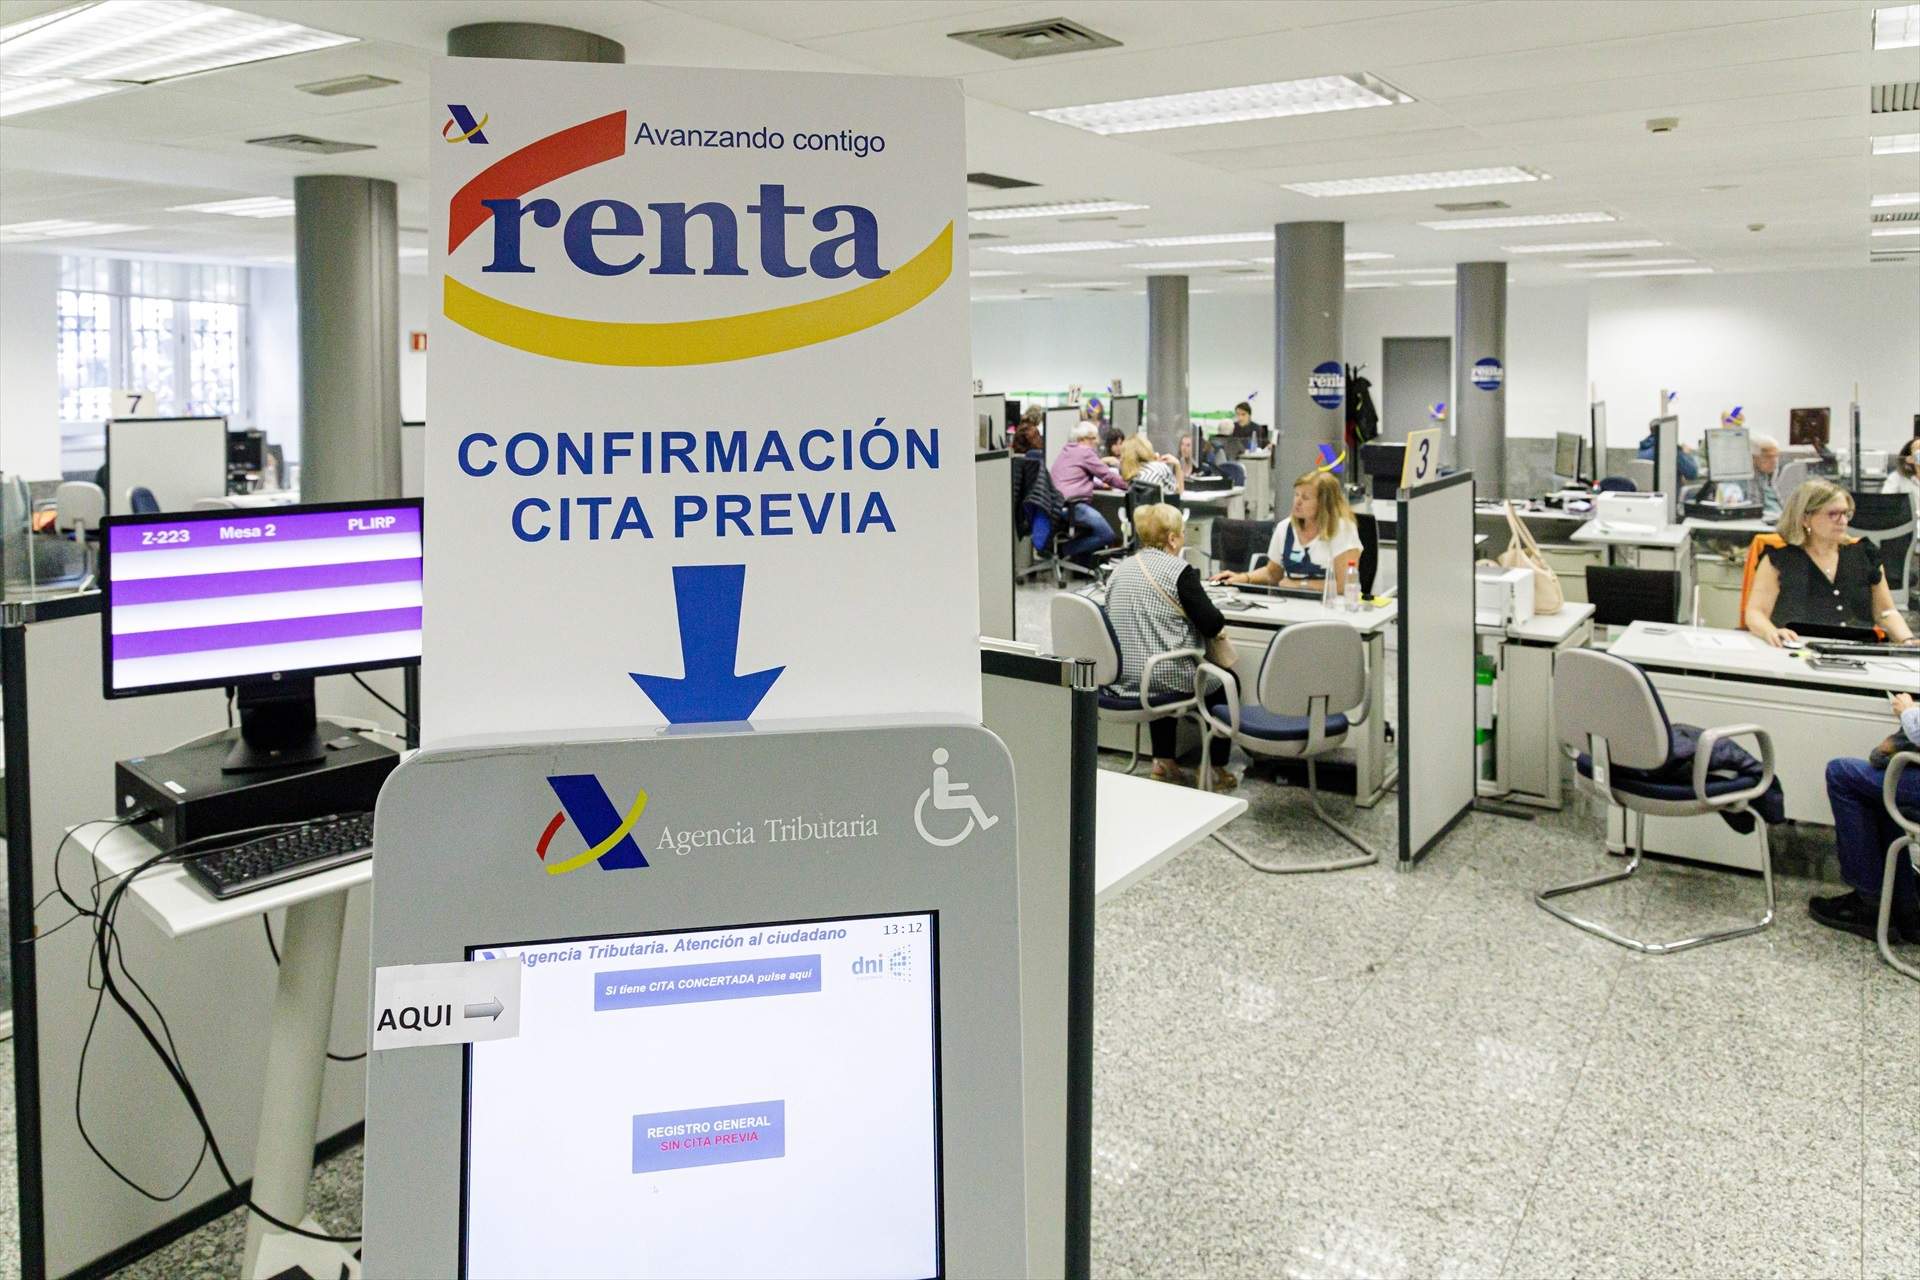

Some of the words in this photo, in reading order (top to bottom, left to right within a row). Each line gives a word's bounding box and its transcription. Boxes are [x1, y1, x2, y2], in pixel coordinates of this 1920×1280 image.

[634, 121, 785, 151] Avanzando
[792, 128, 886, 157] contigo
[481, 183, 890, 279] renta
[126, 394, 142, 414] 7
[457, 417, 940, 477] CONFIRMACIÓN
[1416, 438, 1430, 480] 3
[142, 529, 190, 545] Z-223
[219, 526, 261, 540] Mesa
[264, 523, 276, 537] 2
[348, 515, 396, 531] PL.IRP
[511, 496, 654, 542] CITA
[673, 491, 897, 538] PREVIA
[656, 820, 756, 856] Agencia
[763, 814, 879, 843] Tributaria
[588, 941, 669, 960] Tributaria.
[673, 934, 744, 953] Atención
[749, 932, 763, 946] al
[766, 926, 847, 945] ciudadano
[883, 922, 923, 935] 13:12
[852, 953, 883, 975] dni
[620, 982, 647, 994] tiene
[649, 980, 675, 992] CITA
[678, 974, 755, 989] CONCERTADA
[757, 971, 786, 984] pulse
[376, 1004, 452, 1031] AQUI
[647, 1121, 711, 1139] REGISTRO
[713, 1115, 772, 1132] GENERAL
[660, 1140, 681, 1152] SIN
[683, 1136, 712, 1149] CITA
[715, 1130, 759, 1145] PREVIA
